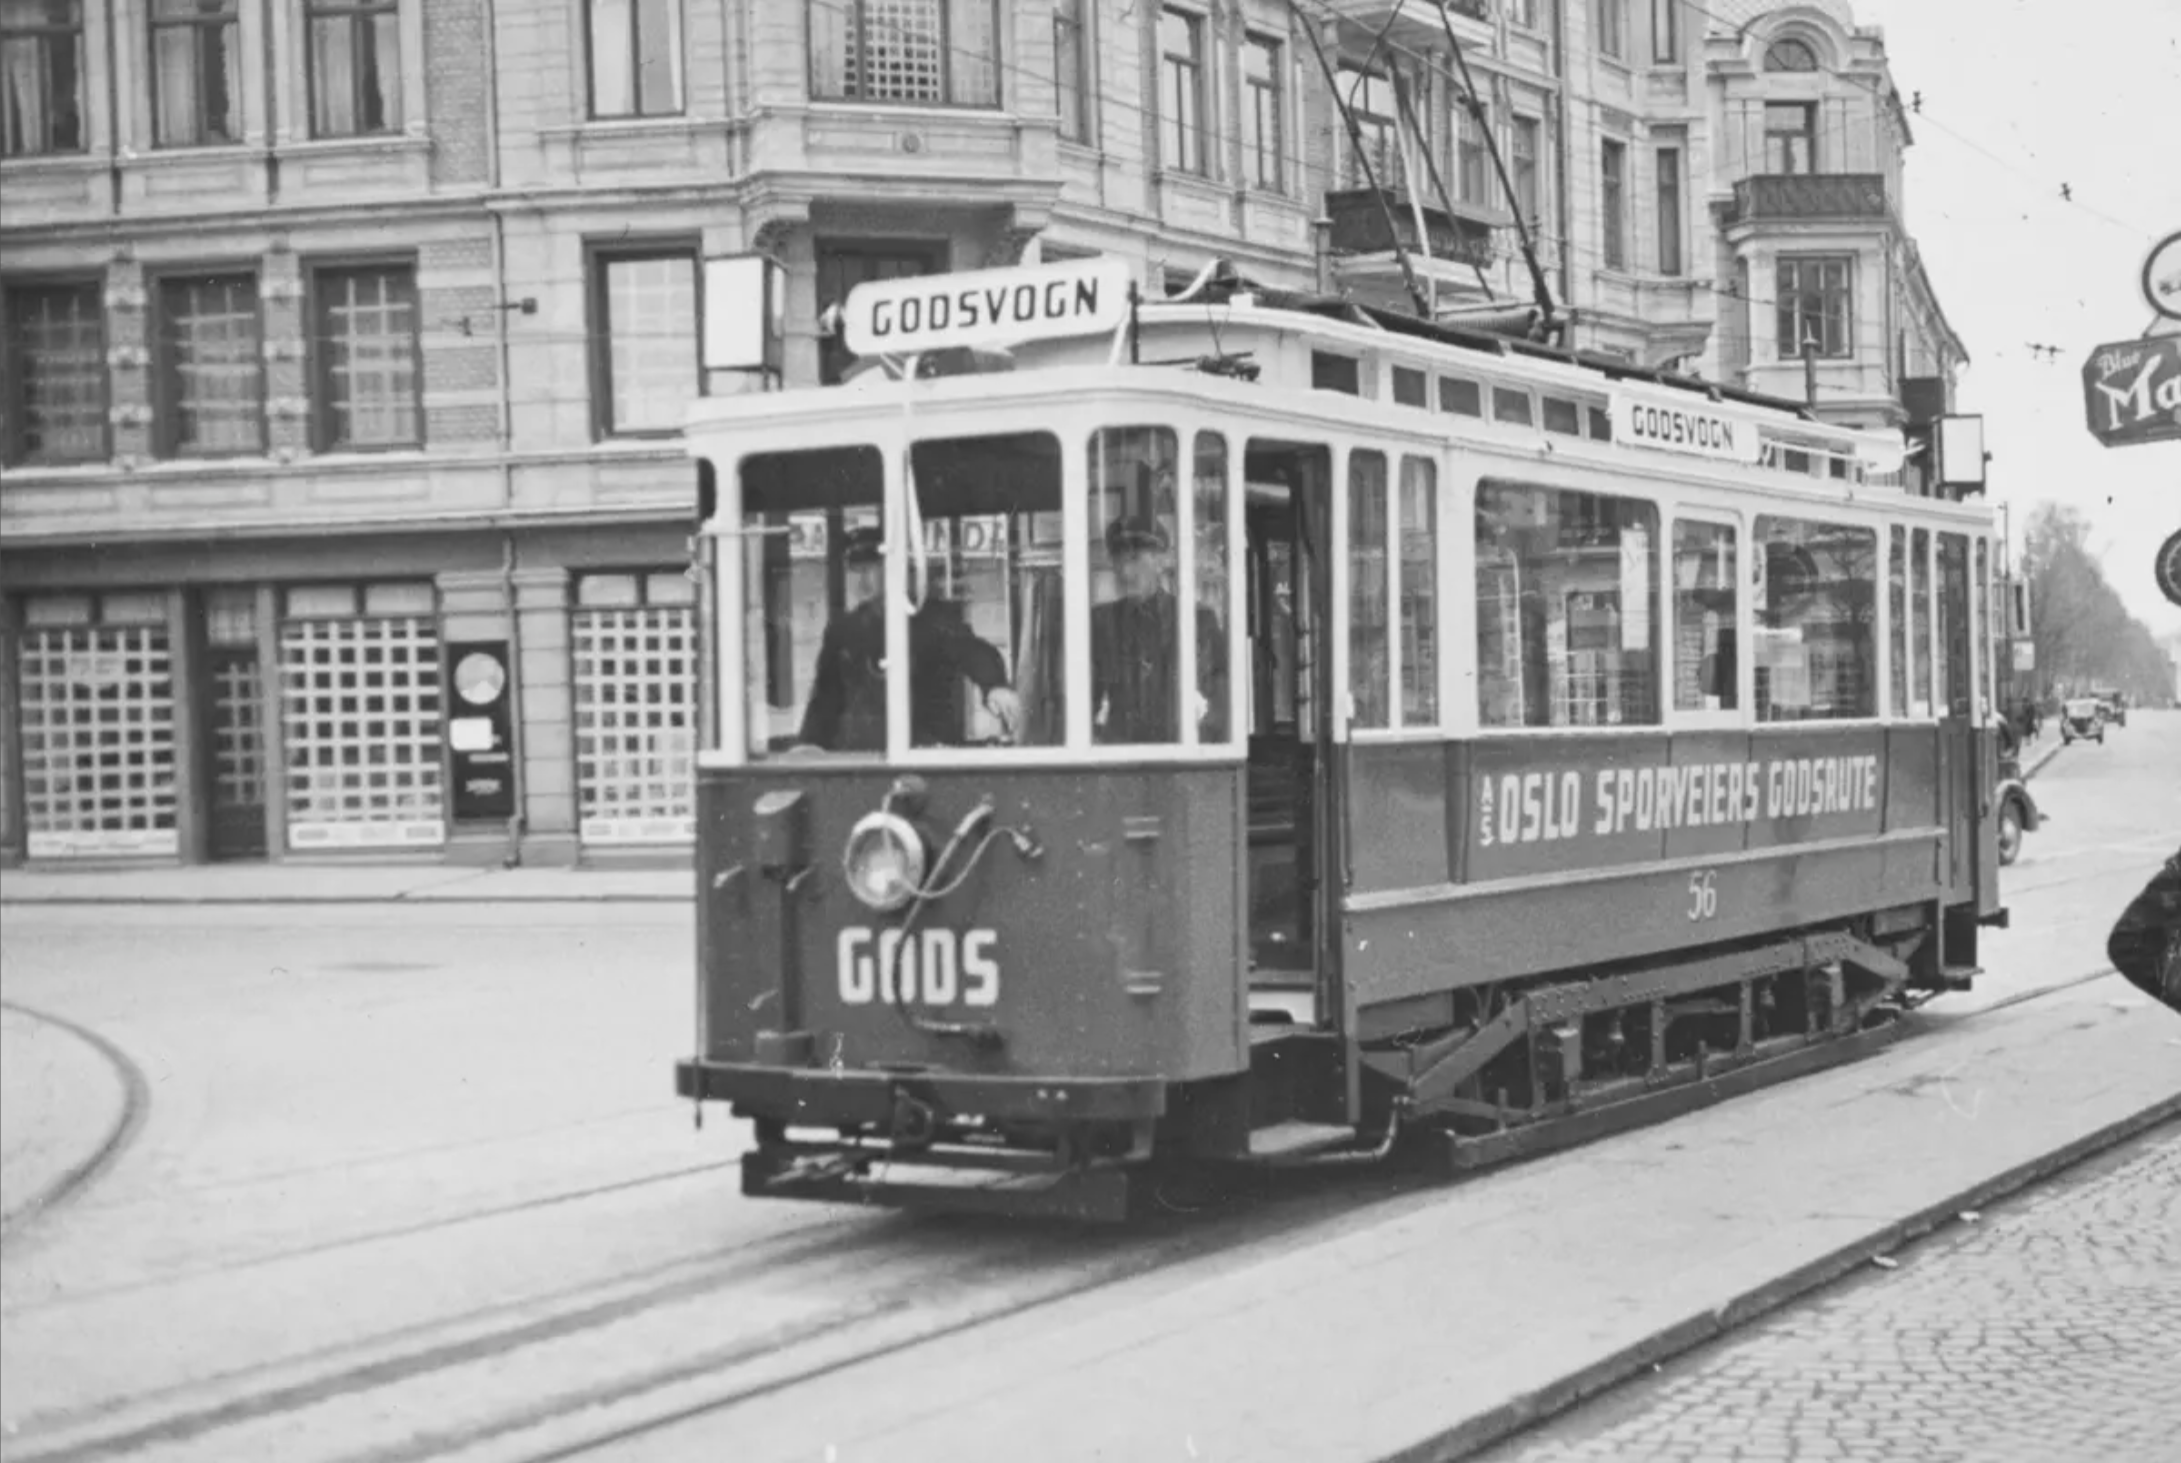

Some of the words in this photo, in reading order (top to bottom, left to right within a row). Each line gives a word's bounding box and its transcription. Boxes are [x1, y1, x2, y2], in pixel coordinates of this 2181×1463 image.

[871, 277, 1098, 337] GODSVOGN
[2096, 350, 2140, 380] Blue
[1632, 404, 1734, 450] GODSVOGN
[1499, 771, 1581, 843] OSLO
[1595, 762, 1760, 834] SPORVEIERS
[1767, 755, 1876, 818] GODSRUTE
[1687, 869, 1717, 920] 56
[837, 925, 1000, 1005] GODS
